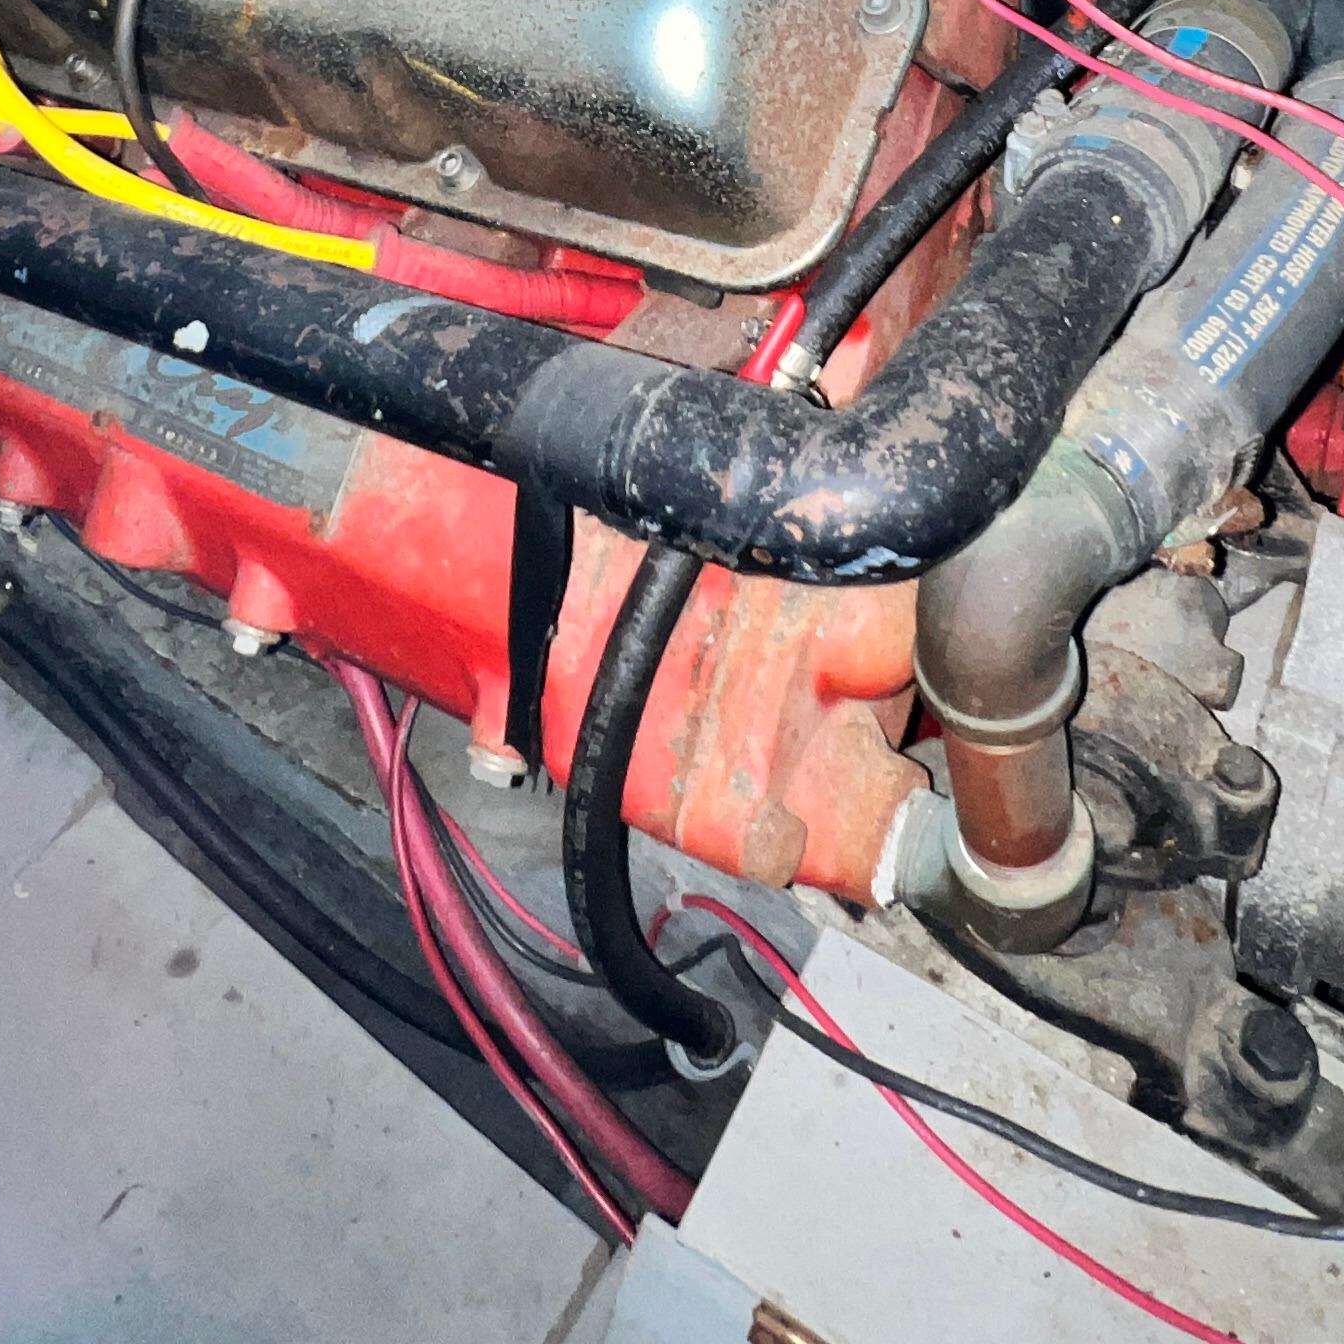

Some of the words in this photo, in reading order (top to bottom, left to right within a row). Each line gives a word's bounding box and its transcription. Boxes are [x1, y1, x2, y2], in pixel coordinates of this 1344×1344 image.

[1268, 182, 1327, 256] APPROVED
[1238, 252, 1279, 294] CERT
[1278, 242, 1319, 289] HOSE
[1221, 285, 1251, 314] 03
[1181, 314, 1228, 361] 60002
